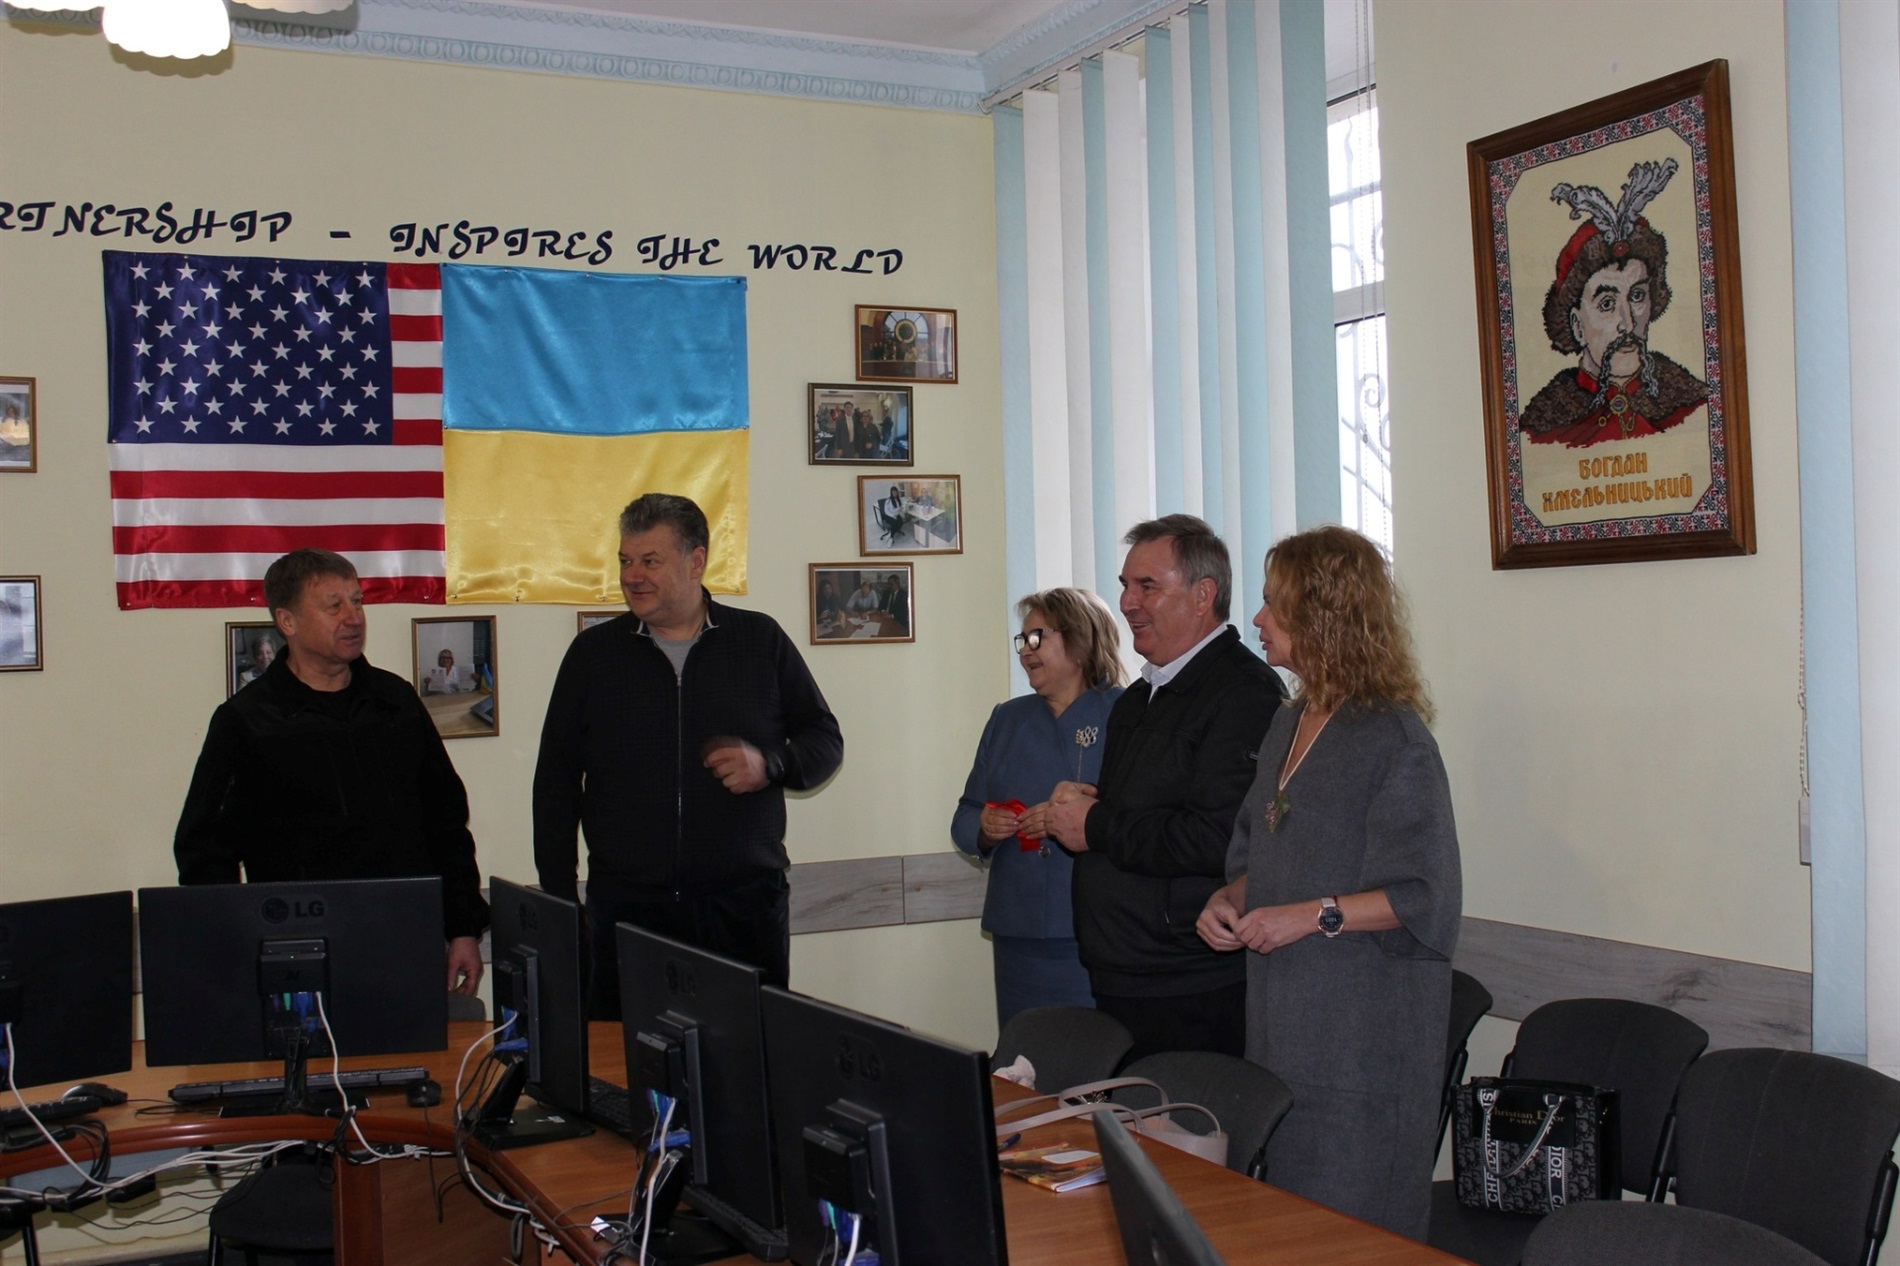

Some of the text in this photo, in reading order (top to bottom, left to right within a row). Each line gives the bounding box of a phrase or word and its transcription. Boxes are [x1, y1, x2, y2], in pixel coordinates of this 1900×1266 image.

[389, 220, 613, 266] INSPIRES
[637, 234, 724, 271] THE
[747, 244, 903, 275] WORLD
[295, 900, 325, 918] LG
[859, 1051, 881, 1082] LG
[1494, 1107, 1566, 1123] hristian Dor
